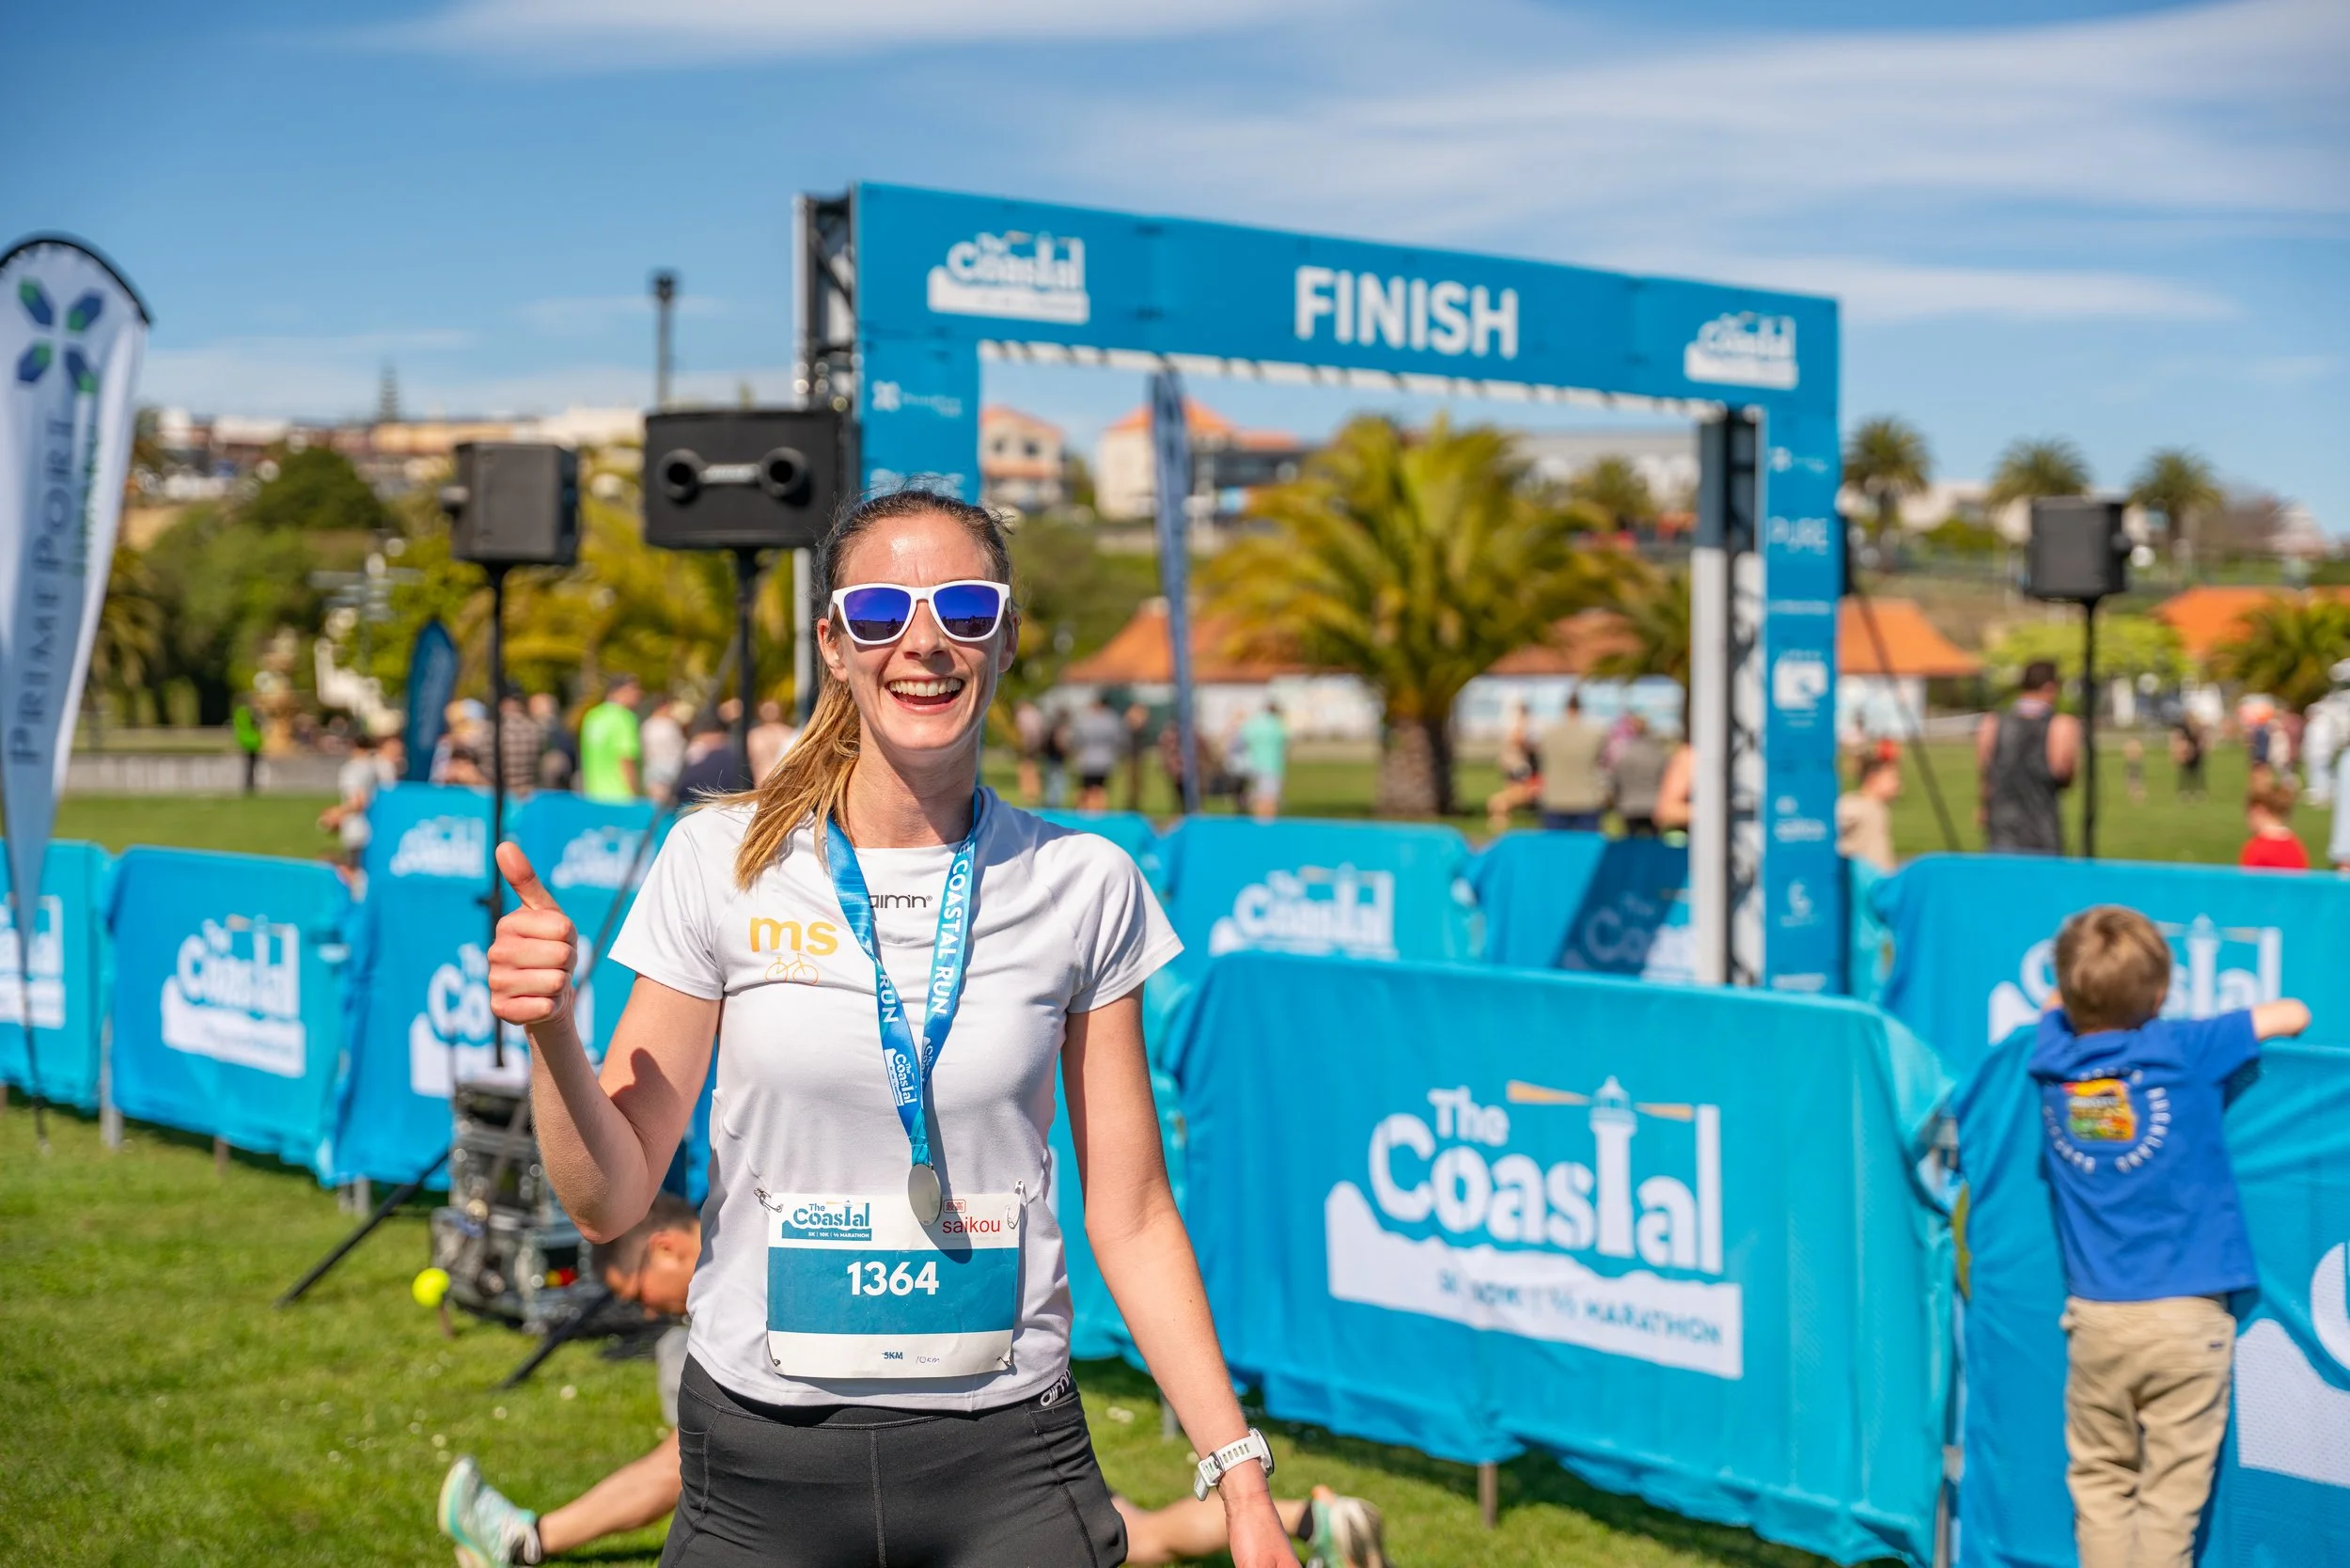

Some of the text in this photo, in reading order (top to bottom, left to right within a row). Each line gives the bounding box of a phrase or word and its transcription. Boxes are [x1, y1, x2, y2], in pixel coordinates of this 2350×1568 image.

[1294, 264, 1519, 361] FINISH
[936, 859, 969, 960] COASTAL
[750, 917, 838, 956] ms
[879, 974, 900, 1024] RUN
[932, 964, 955, 1014] RUN
[1427, 1085, 1511, 1147] The
[808, 1203, 825, 1212] The
[942, 1216, 1001, 1233] saikou
[847, 1261, 940, 1296] 1364
